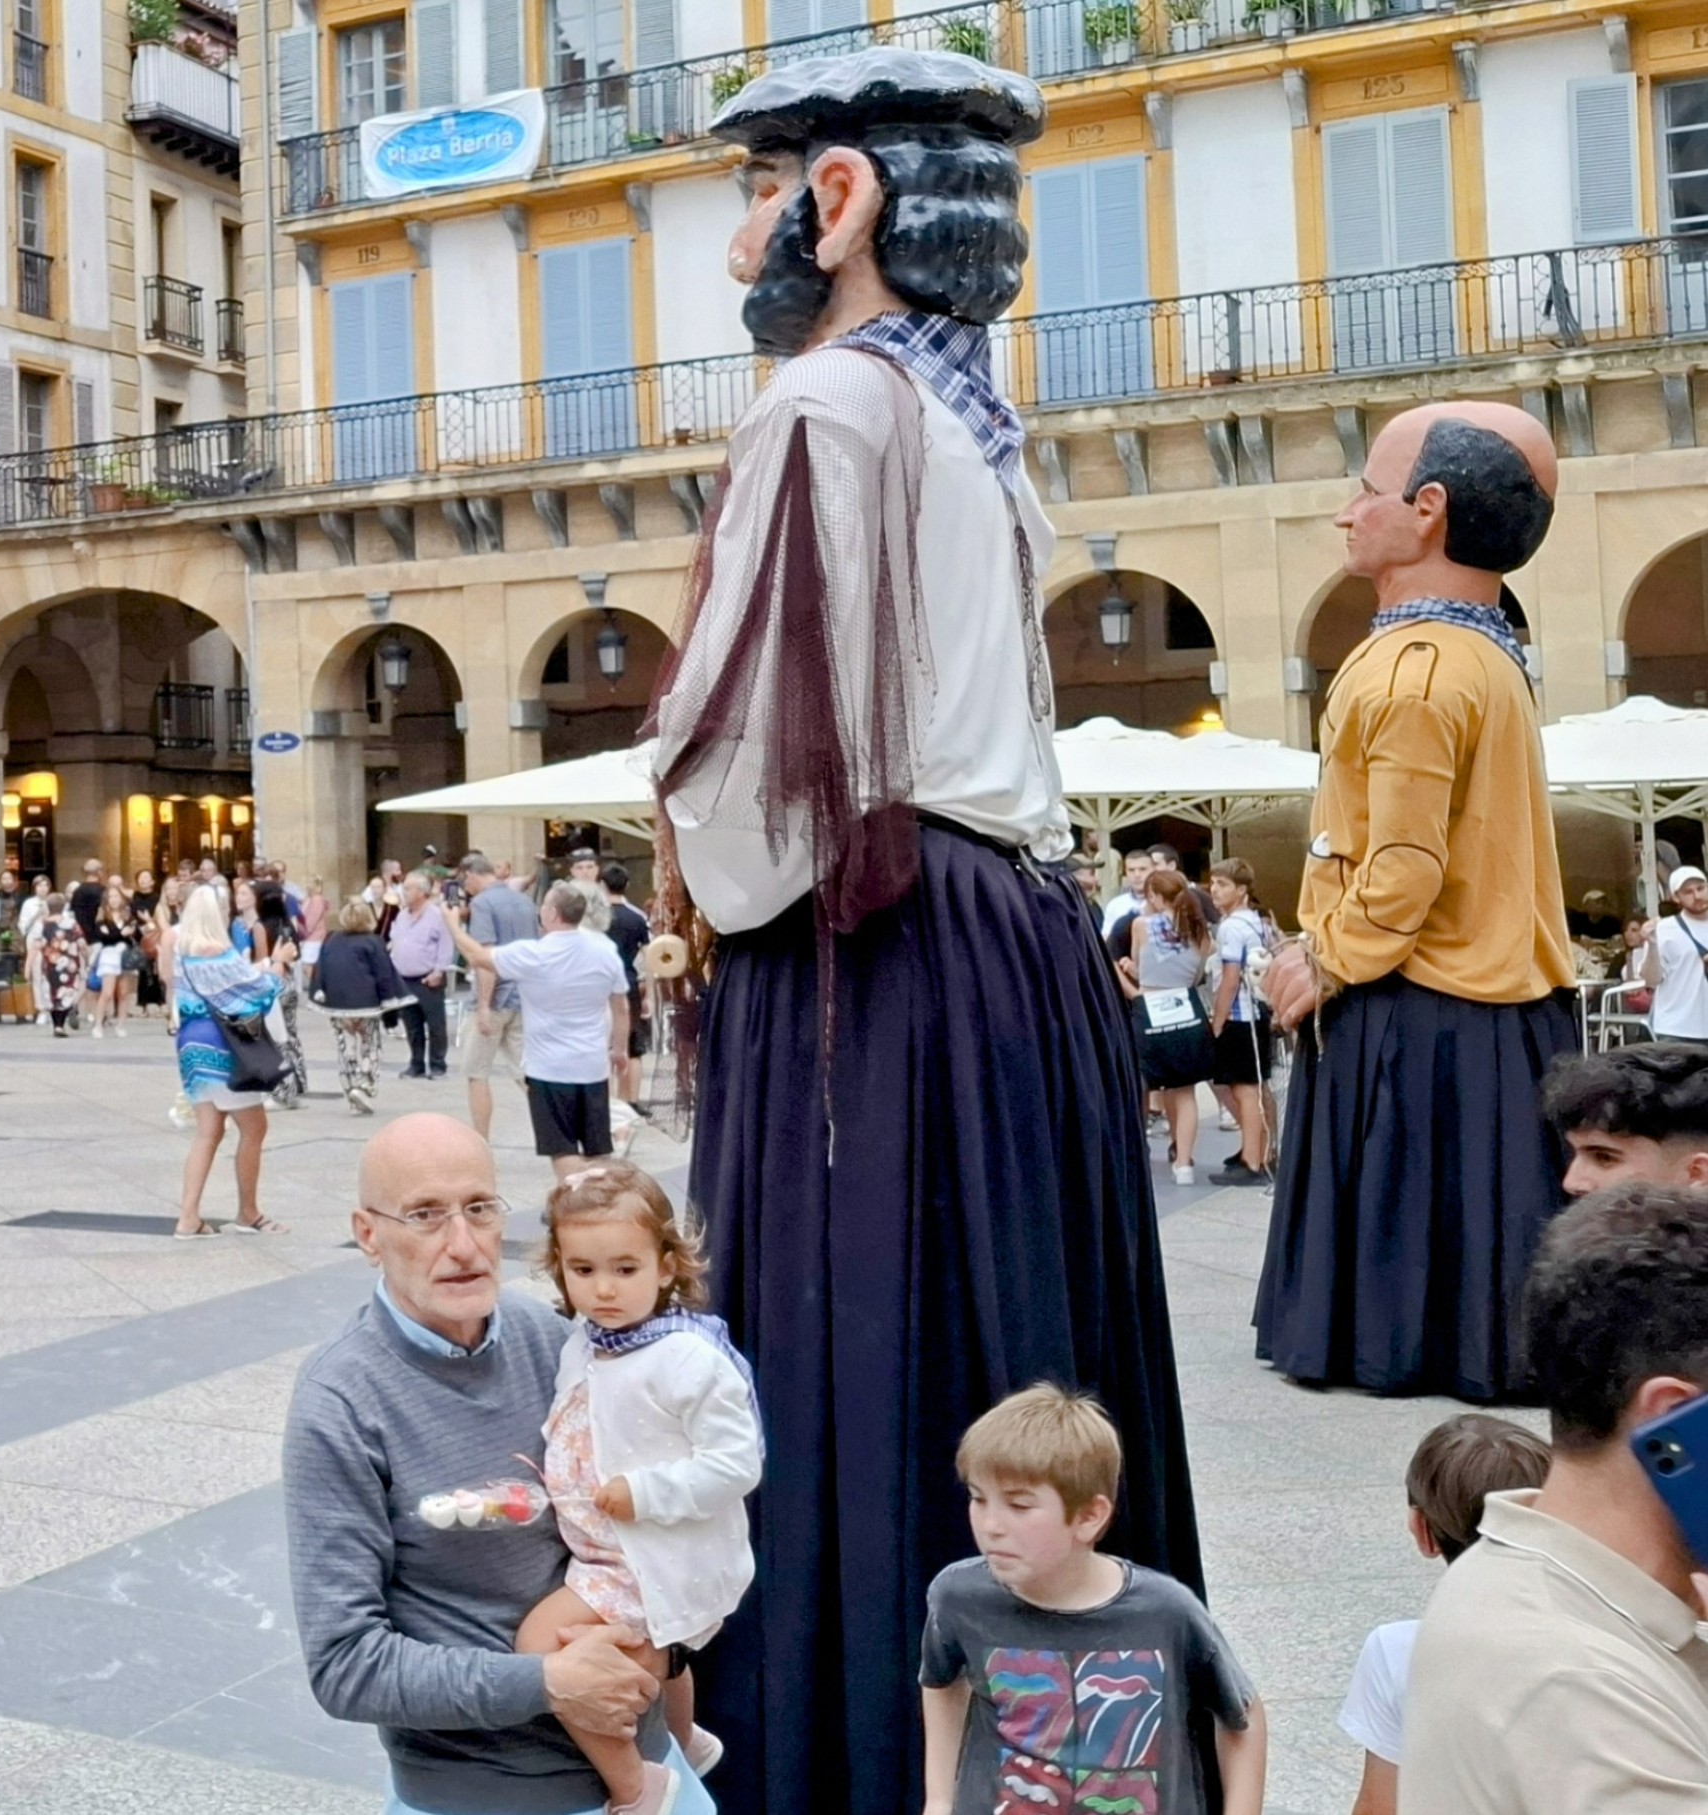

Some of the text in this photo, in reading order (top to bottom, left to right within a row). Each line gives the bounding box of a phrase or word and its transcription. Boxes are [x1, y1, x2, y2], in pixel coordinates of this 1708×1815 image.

[1362, 74, 1405, 100] 123
[387, 130, 514, 167] Plaza Berria
[357, 245, 381, 264] 119
